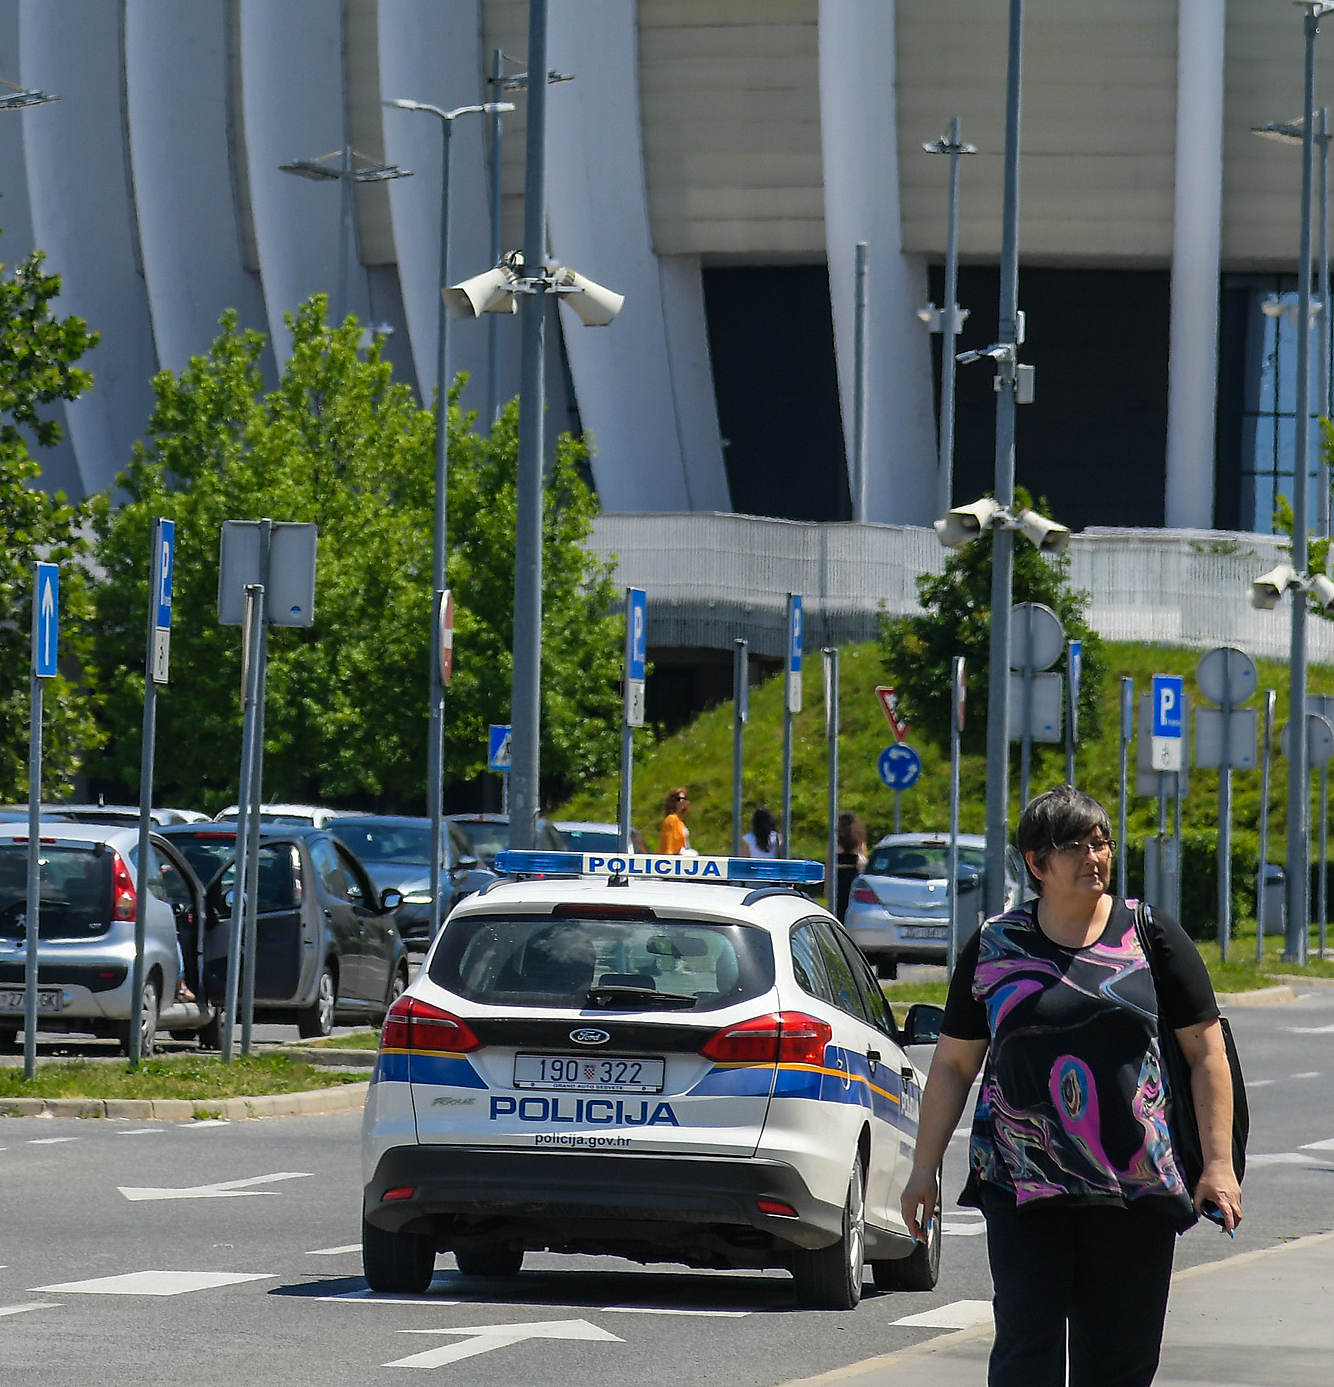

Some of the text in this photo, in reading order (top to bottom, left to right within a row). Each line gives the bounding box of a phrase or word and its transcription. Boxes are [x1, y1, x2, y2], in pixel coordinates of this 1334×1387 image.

[161, 541, 169, 605] P
[634, 606, 643, 661] P
[1160, 688, 1174, 726] P
[589, 857, 721, 877] POLICIJA
[539, 1059, 643, 1084] 190 322
[489, 1095, 680, 1127] POLICIJA
[535, 1131, 632, 1147] policija.gov.hr
